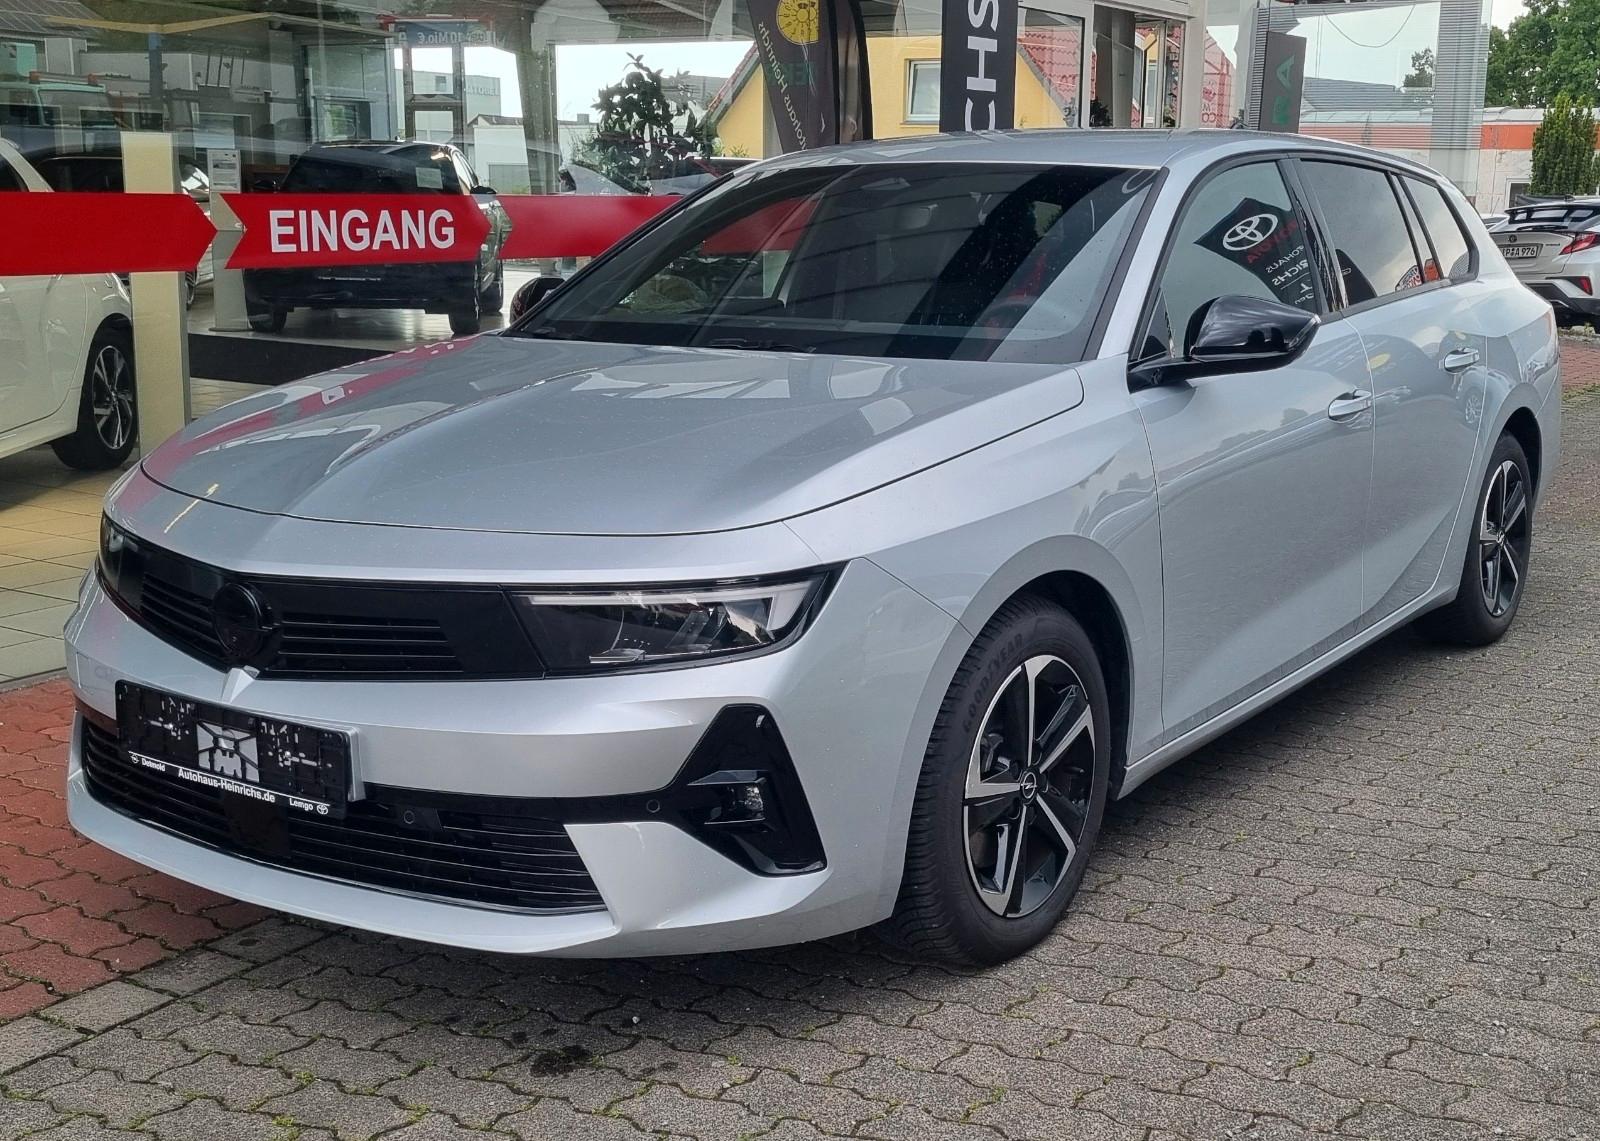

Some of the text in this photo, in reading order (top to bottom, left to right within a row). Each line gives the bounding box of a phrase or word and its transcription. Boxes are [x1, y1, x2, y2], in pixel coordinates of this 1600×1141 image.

[269, 209, 455, 253] EINGANG
[1521, 246, 1536, 256] 976
[962, 632, 1024, 734] GOODYEAR
[141, 757, 314, 811] Detmold Autohaus-Heinrichs.de Lemgo
